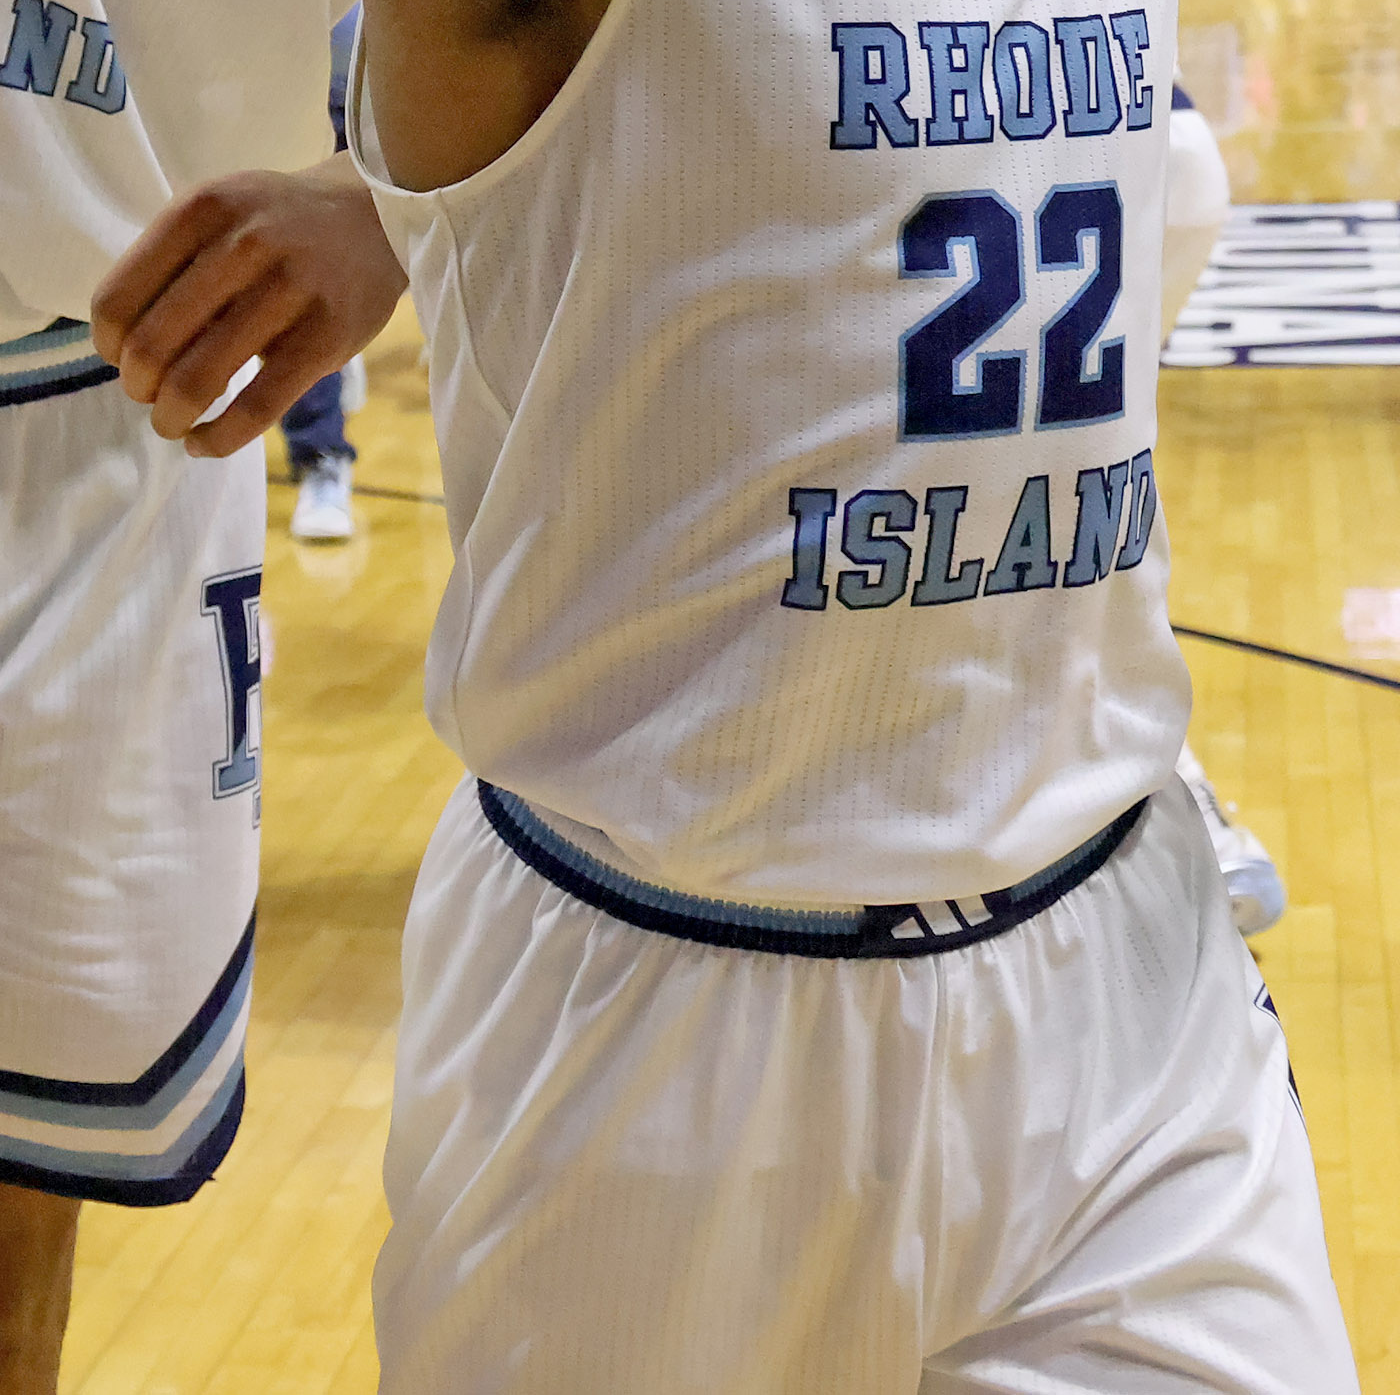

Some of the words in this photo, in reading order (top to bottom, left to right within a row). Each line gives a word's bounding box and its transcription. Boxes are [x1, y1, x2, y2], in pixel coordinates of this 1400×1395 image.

[830, 8, 1154, 150] RHODE
[897, 180, 1126, 443] 22
[780, 448, 1156, 610] ISLAND
